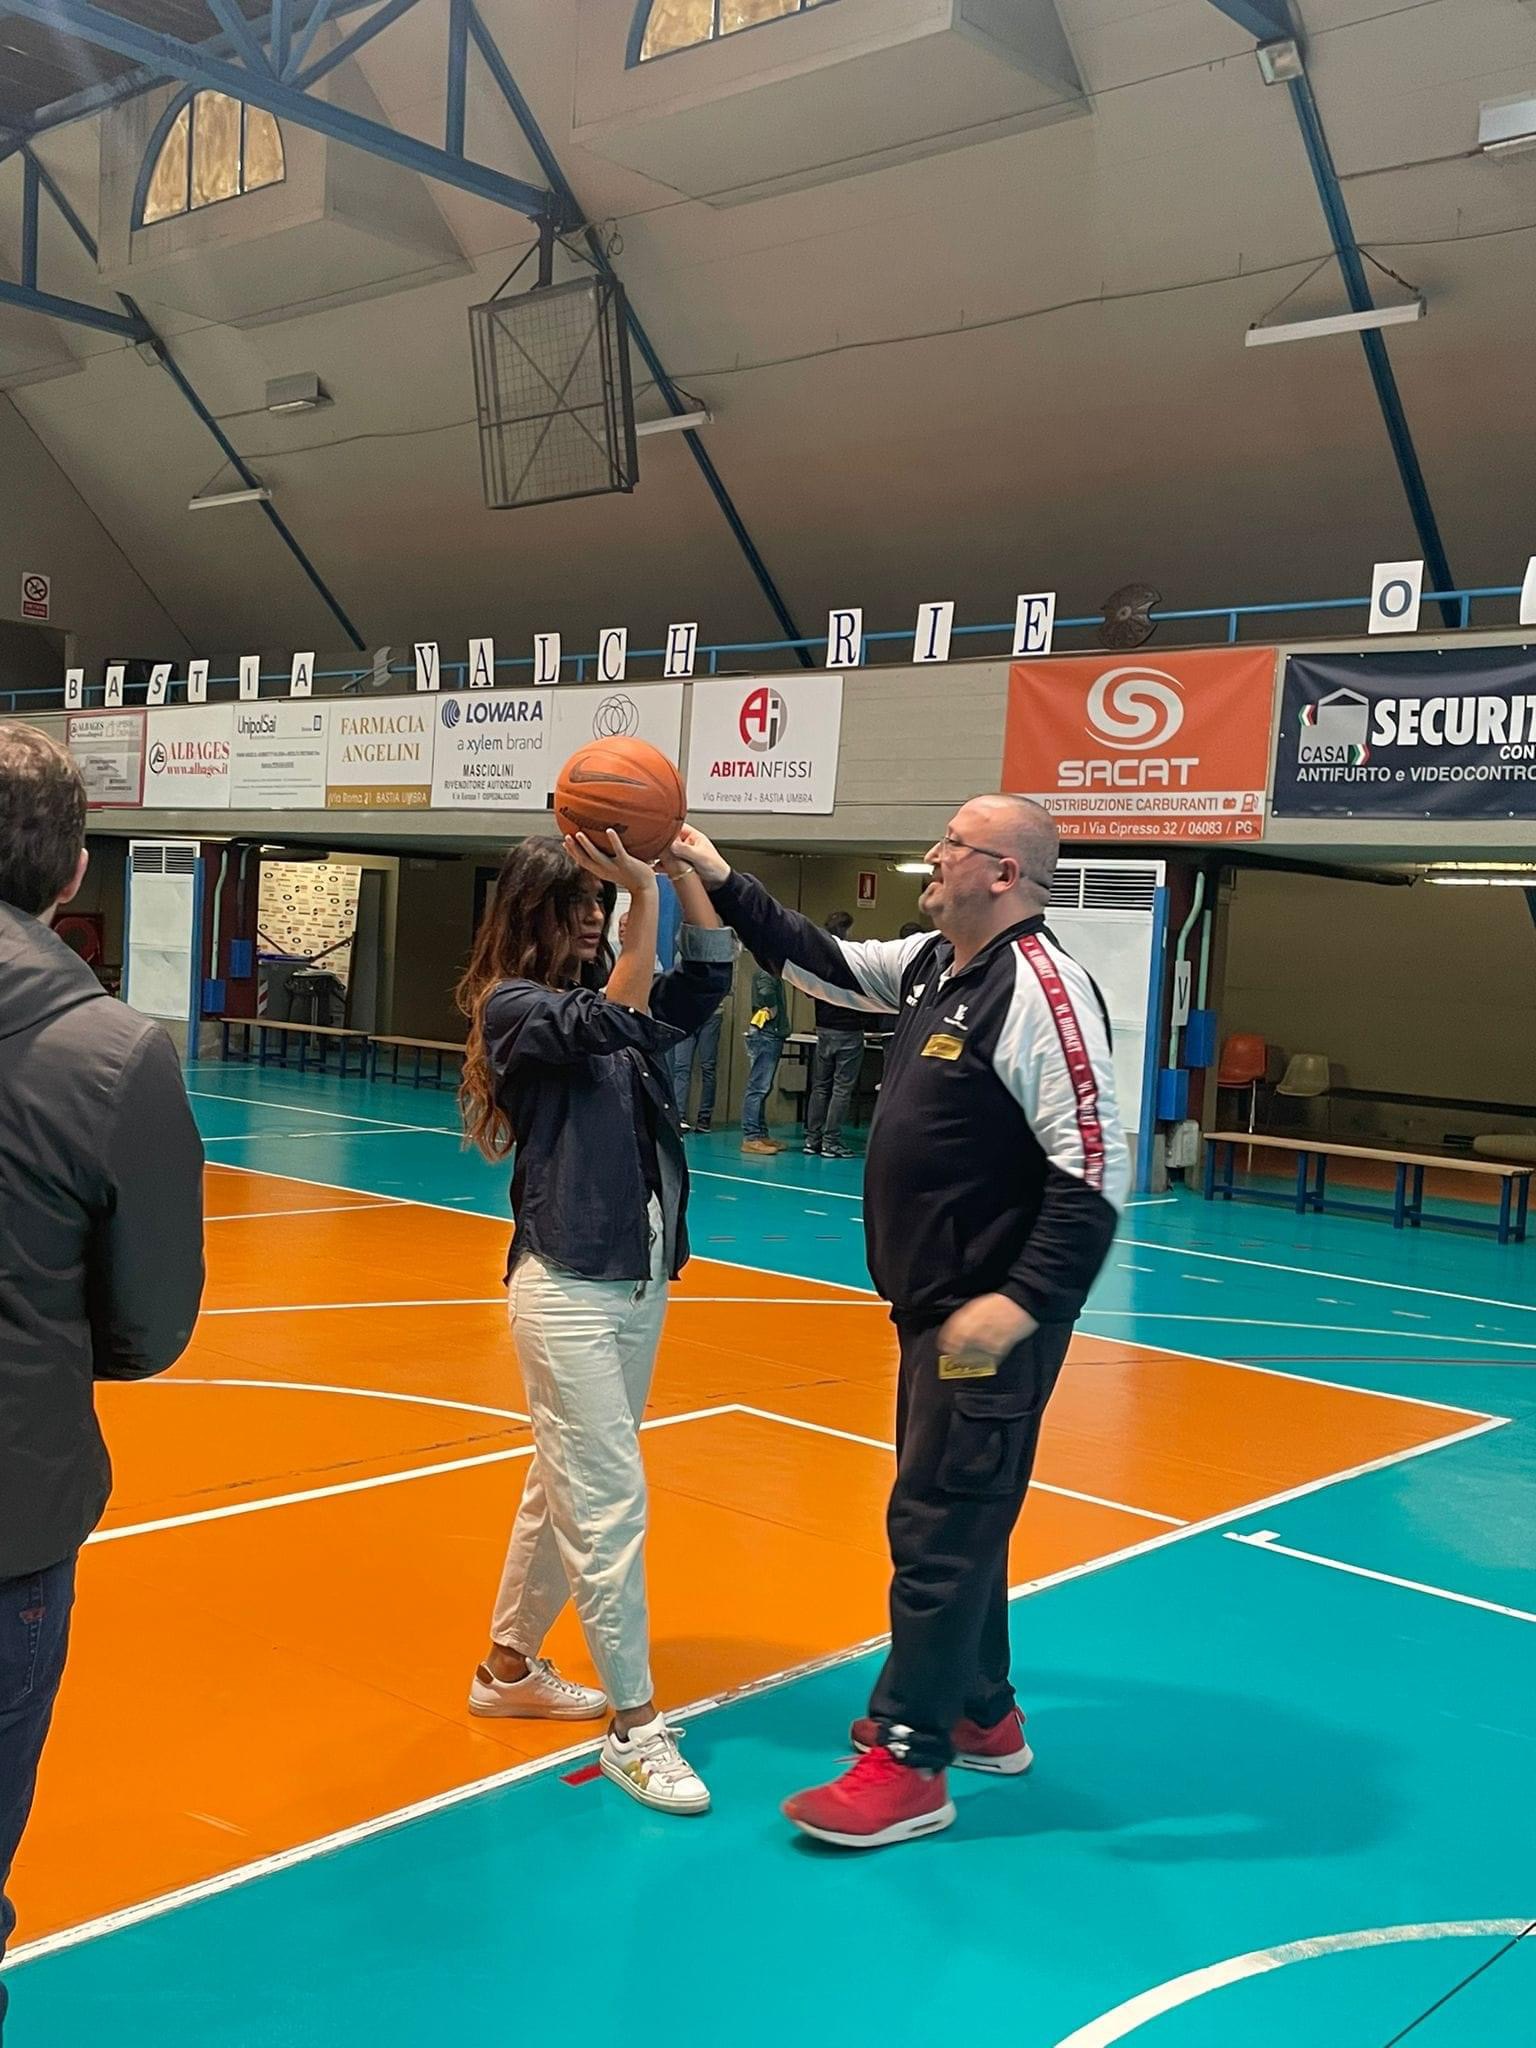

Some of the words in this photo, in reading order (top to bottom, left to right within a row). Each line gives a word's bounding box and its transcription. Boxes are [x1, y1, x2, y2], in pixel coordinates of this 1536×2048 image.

[1379, 579, 1412, 618] O
[466, 700, 543, 723] LOWARA
[340, 715, 425, 735] FARMACIA
[168, 741, 230, 760] ALBAGES
[457, 739, 464, 751] a
[467, 733, 503, 755] xylem
[506, 731, 543, 750] brand
[342, 742, 421, 763] ANGELINI
[1301, 746, 1346, 762] CASA
[166, 762, 228, 778] www.albages.it
[463, 764, 514, 777] MASCIOLINI
[710, 761, 812, 778] ABITAINFISSI
[1057, 757, 1199, 787] SACAT
[1296, 766, 1391, 783] ANTIFURTO
[1395, 770, 1406, 782] e
[1043, 798, 1133, 811] DISTRIBUZIONE
[1136, 797, 1218, 811] CARBURANTI
[1056, 822, 1080, 834] bra
[1089, 822, 1106, 834] Via
[1109, 821, 1160, 837] Cipresso
[1163, 821, 1178, 835] 32
[1188, 821, 1222, 835] 06083
[1235, 821, 1252, 835] PG
